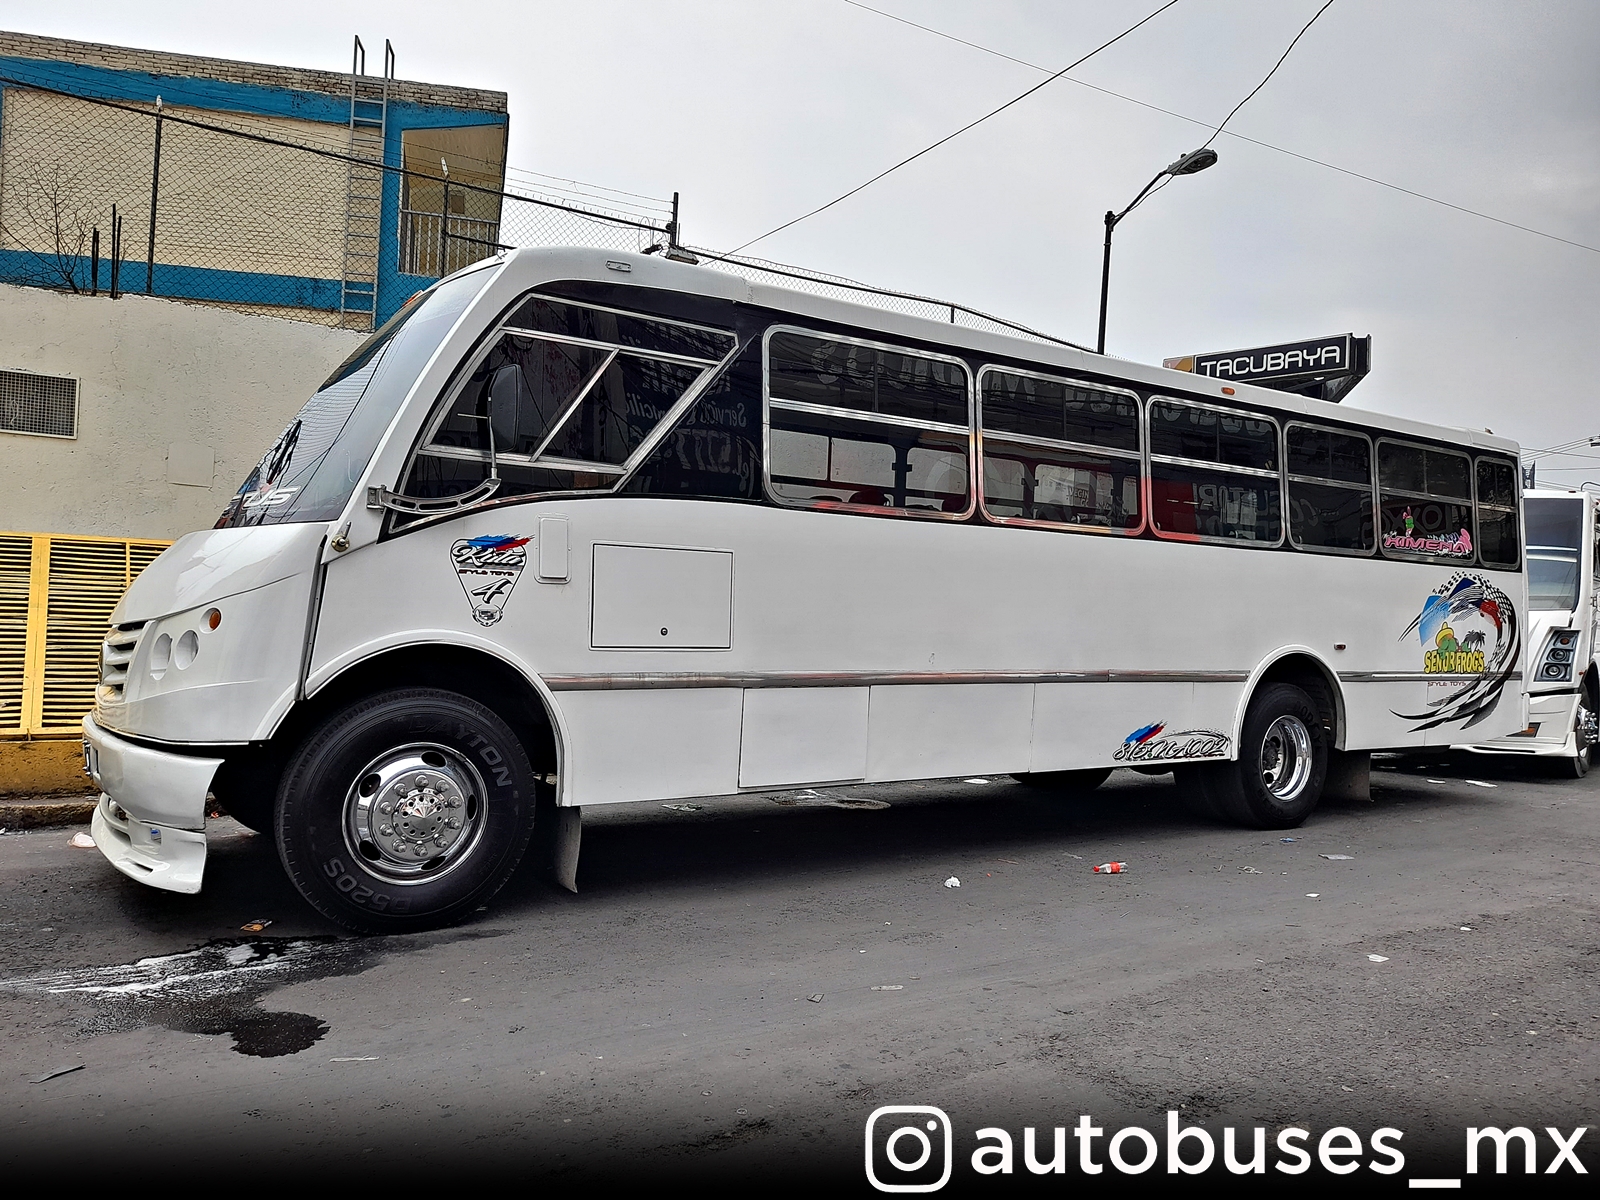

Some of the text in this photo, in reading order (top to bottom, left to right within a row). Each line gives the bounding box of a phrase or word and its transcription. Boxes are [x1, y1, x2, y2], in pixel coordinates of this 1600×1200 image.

[1200, 345, 1341, 378] TACUBAYA
[458, 568, 488, 576] STYLE
[470, 578, 514, 605] 4
[405, 715, 513, 788] DAYTON
